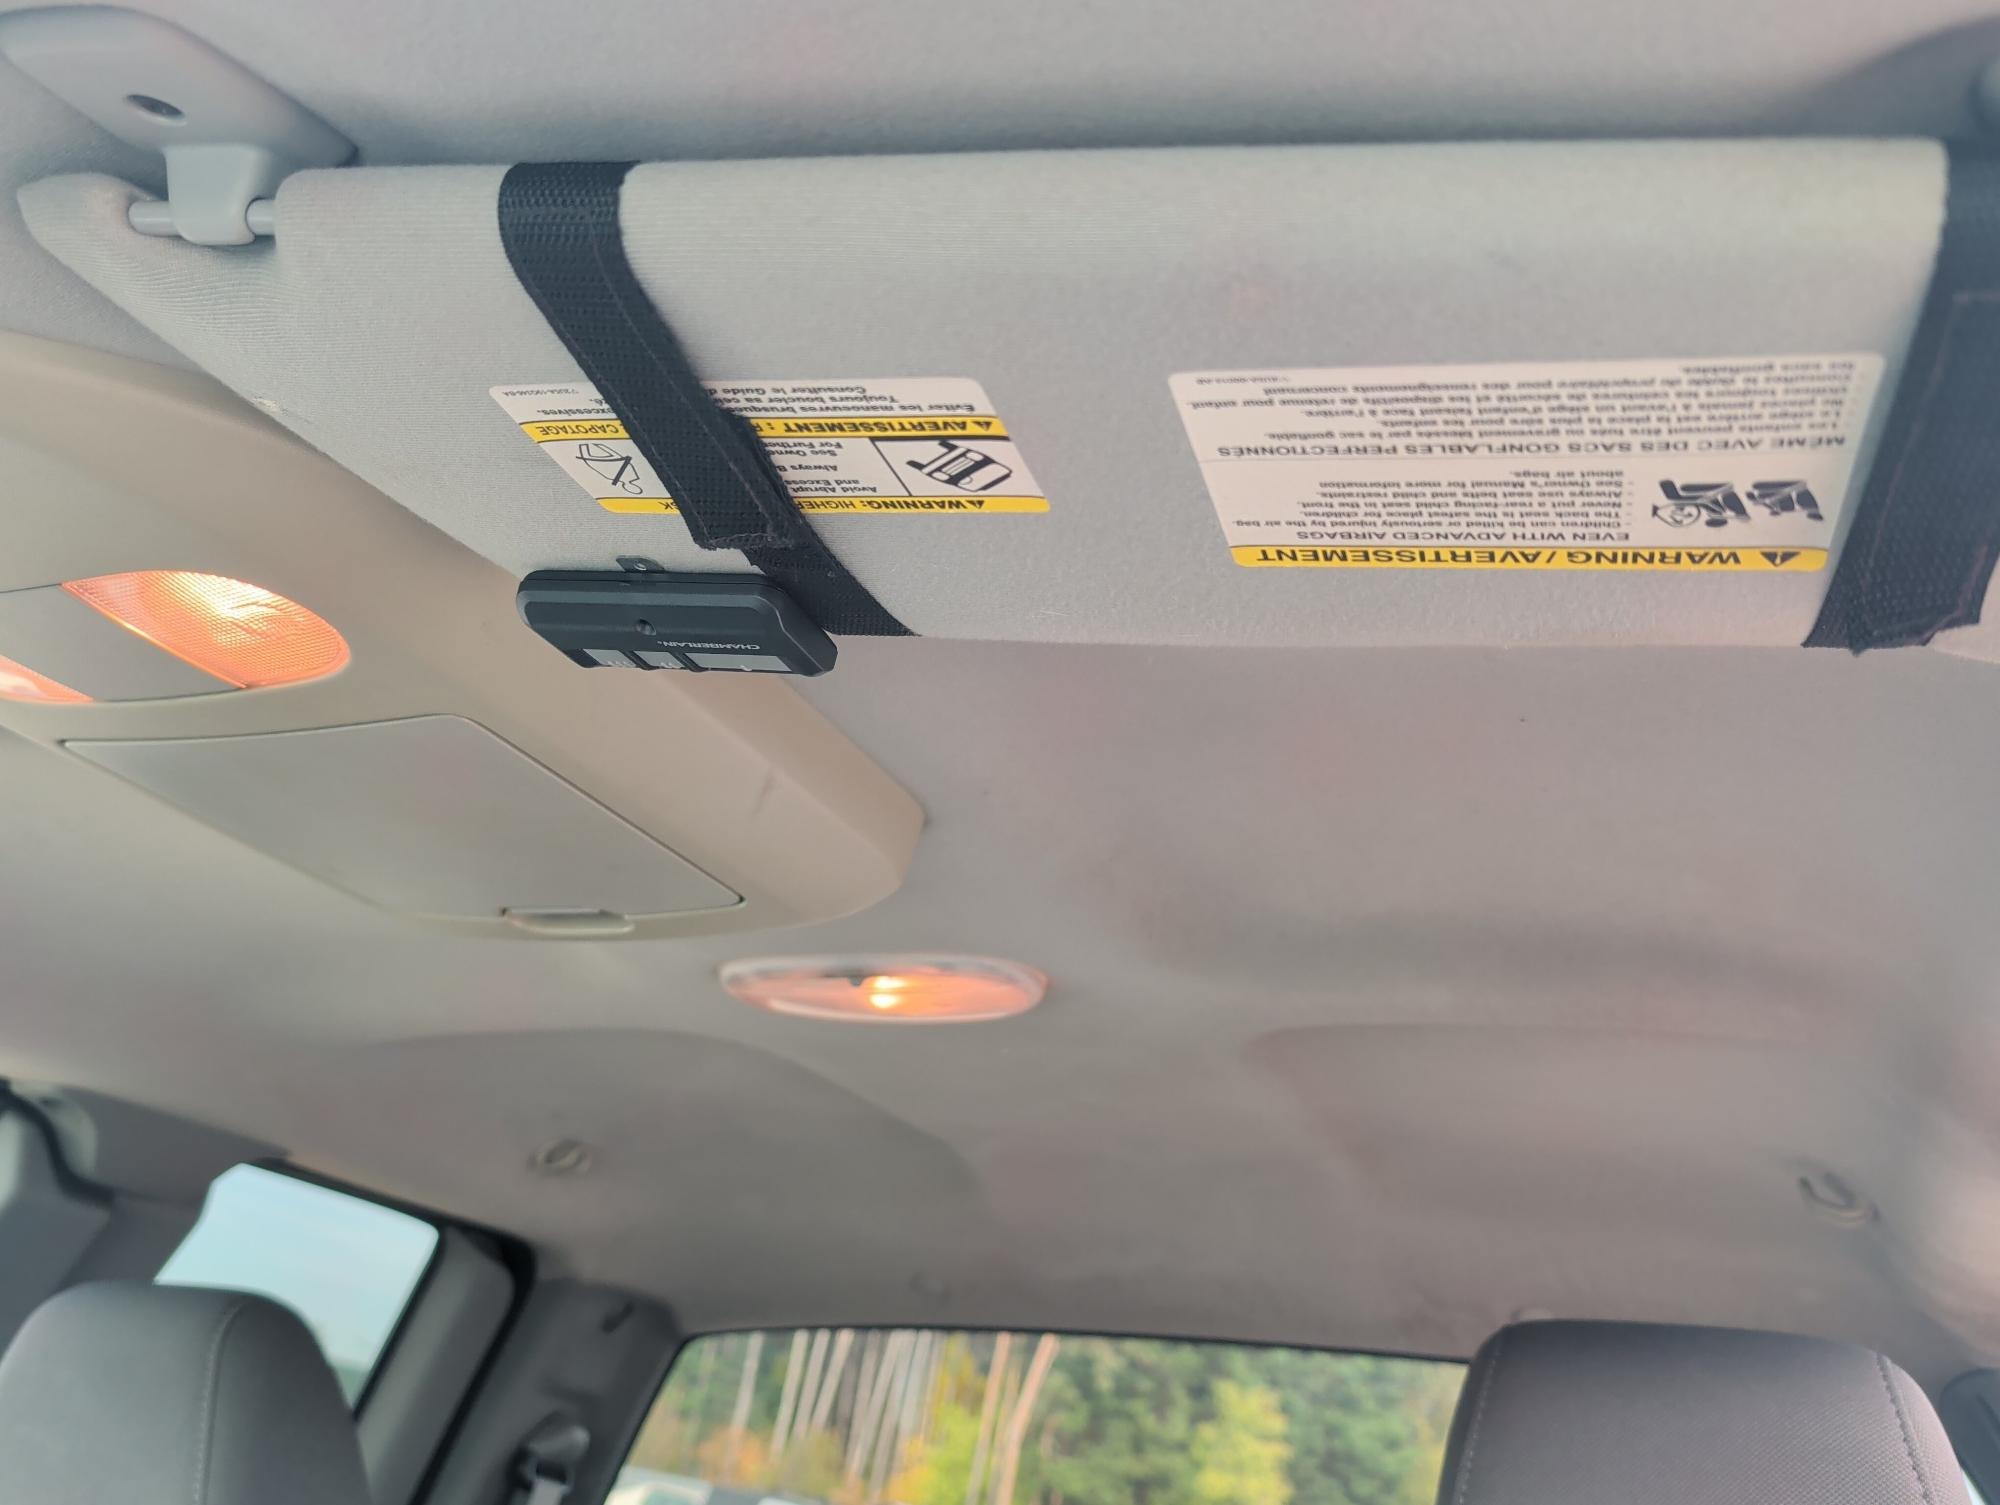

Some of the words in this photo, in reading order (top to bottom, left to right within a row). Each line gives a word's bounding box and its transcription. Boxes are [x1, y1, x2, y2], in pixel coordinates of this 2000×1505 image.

[721, 388, 766, 396] Guide
[771, 387, 787, 396] le
[791, 386, 867, 395] Consulter
[767, 396, 825, 405] boucler
[829, 395, 898, 404] Toujours
[898, 404, 924, 412] les
[535, 424, 620, 436] CAPOTAGE
[783, 421, 968, 433] AVERTISSEMENT
[1403, 443, 1560, 454] GONFLABLES
[1567, 442, 1632, 453] SACS
[1640, 440, 1689, 452] DES
[1697, 439, 1762, 450] AVEC
[1217, 444, 1398, 456] PERFECTIONNÉS
[790, 464, 838, 472] Always
[1510, 469, 1550, 478] bags.
[1580, 471, 1623, 479] about
[1318, 481, 1400, 489] information
[1447, 481, 1467, 489] for
[1470, 481, 1525, 489] Manual
[791, 485, 836, 494] Abrupt
[840, 486, 877, 494] Avoid
[1392, 491, 1427, 500] child
[1431, 491, 1457, 499] and
[1461, 491, 1498, 499] belts
[1569, 490, 1623, 498] Always
[797, 500, 857, 510] HIGHE
[860, 500, 968, 510] WARNING:
[1297, 501, 1334, 509] front.
[1338, 501, 1360, 509] the
[1364, 501, 1377, 509] in
[1416, 501, 1449, 509] child
[1454, 500, 1533, 509] rear-facing
[1551, 500, 1576, 508] put
[1299, 511, 1359, 519] children.
[1364, 511, 1382, 519] for
[1386, 509, 1423, 519] place
[1428, 511, 1470, 519] safest
[1475, 511, 1498, 519] the
[1554, 511, 1590, 519] back
[1232, 519, 1261, 527] bag.
[1285, 520, 1306, 528] the
[1311, 519, 1326, 528] by
[1330, 519, 1378, 528] injured
[1381, 519, 1443, 528] seriously
[1466, 521, 1504, 529] killed
[1509, 521, 1526, 529] be
[1296, 532, 1386, 540] AIRBAGS
[1392, 532, 1506, 541] ADVANCED
[1512, 532, 1566, 541] WITH
[1572, 532, 1629, 541] EVEN
[1567, 551, 1741, 565] WARNING
[662, 640, 761, 650] CHAMBERLAIN
